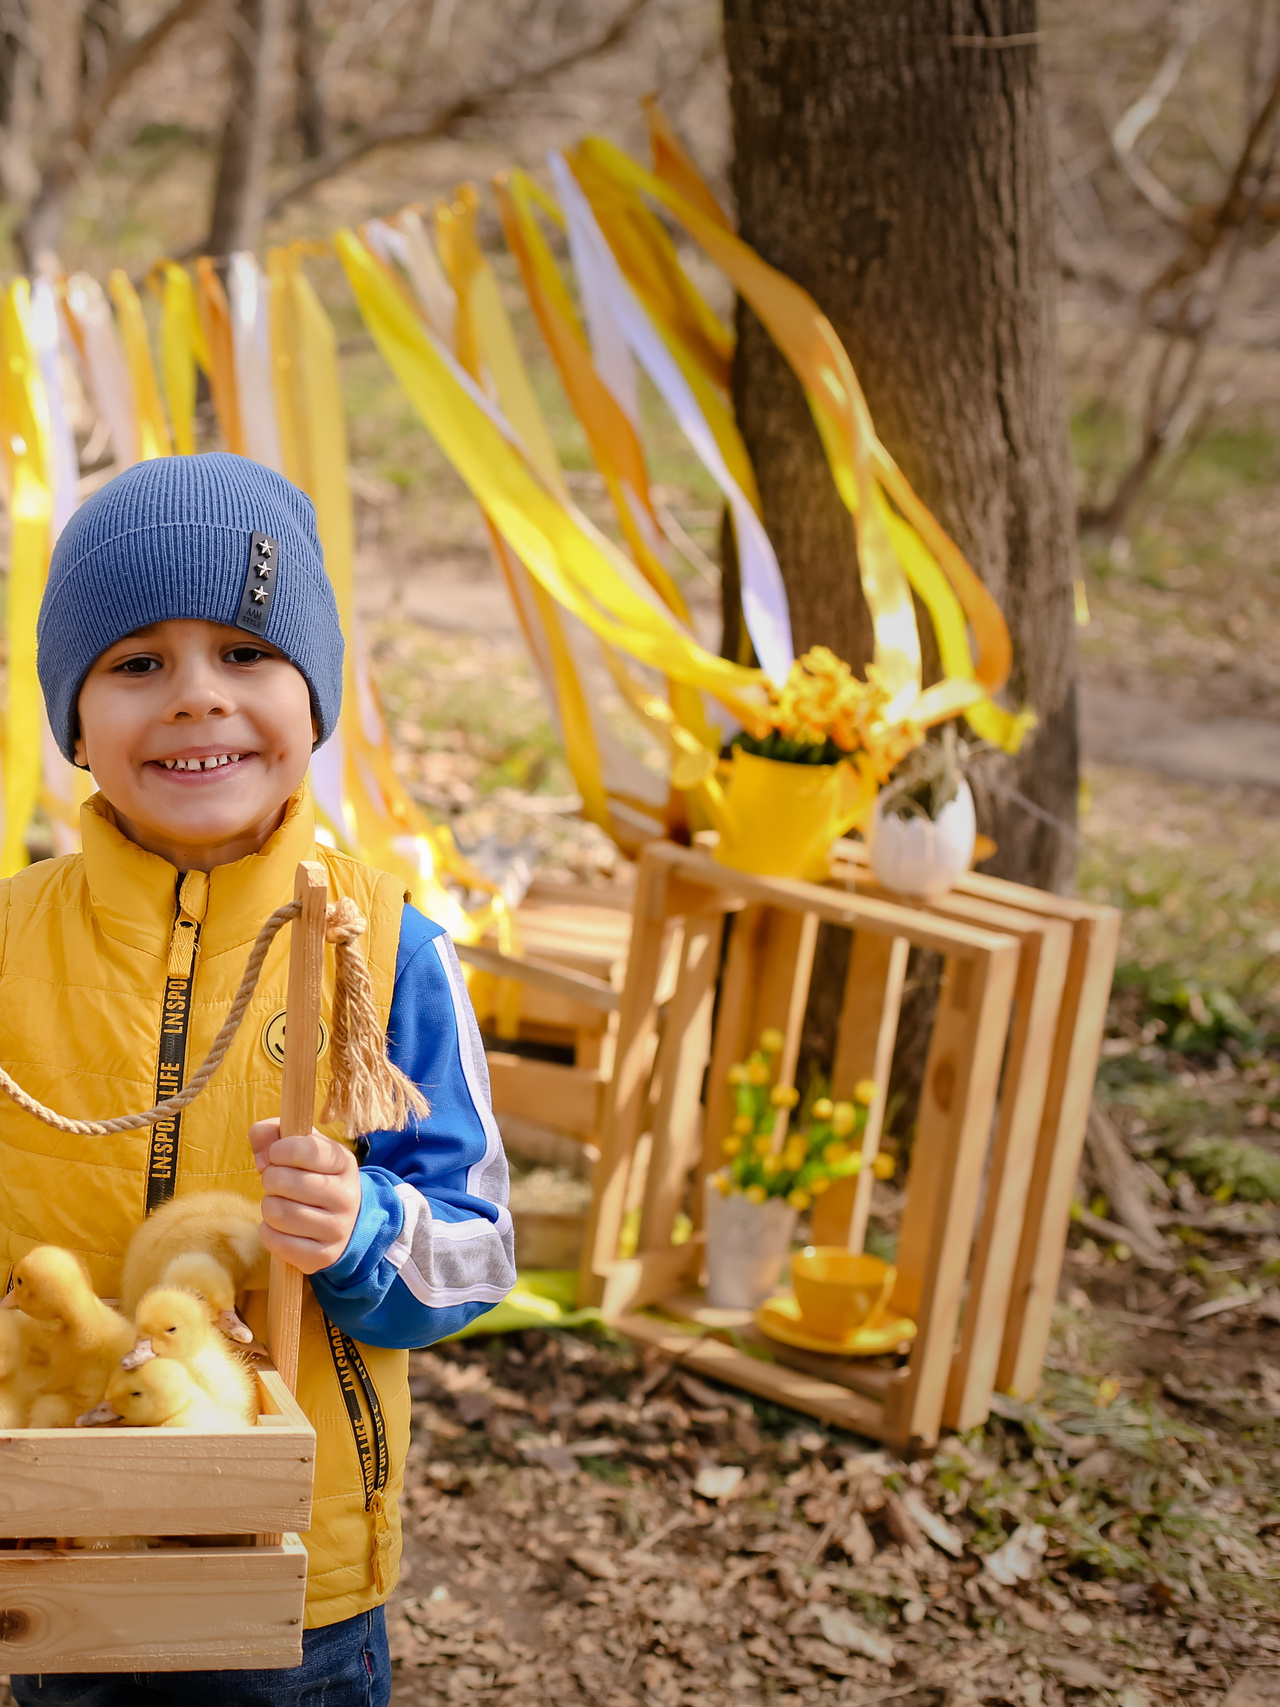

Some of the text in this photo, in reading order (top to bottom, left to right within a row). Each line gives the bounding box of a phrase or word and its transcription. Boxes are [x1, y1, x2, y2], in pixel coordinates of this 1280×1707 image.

[241, 615, 262, 628] STYLE
[163, 976, 188, 1034] LN SPO
[151, 1062, 180, 1179] LN SPO LIFE
